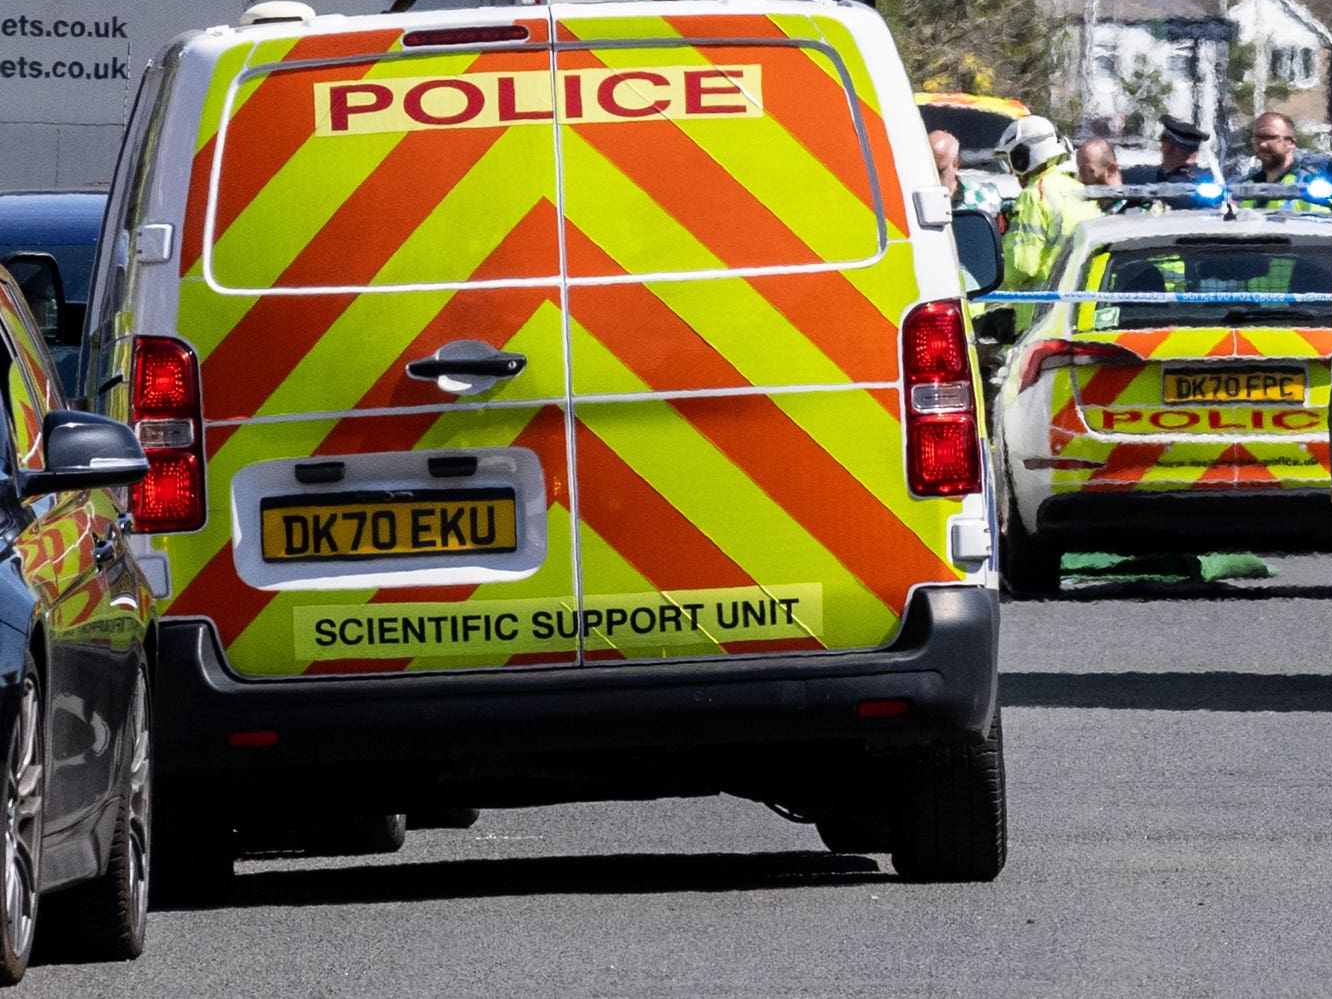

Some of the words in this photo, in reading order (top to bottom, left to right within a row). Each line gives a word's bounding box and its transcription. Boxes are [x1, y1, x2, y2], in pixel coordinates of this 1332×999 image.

[1, 15, 128, 38] ets.co.uk
[0, 57, 129, 80] ets.co.uk
[328, 70, 745, 132] POLICE
[1176, 376, 1240, 399] DK70
[1246, 374, 1294, 397] FPC
[1102, 409, 1320, 430] POLIC
[282, 510, 397, 555] DK70
[411, 505, 496, 548] EKU
[314, 609, 519, 646] SCIENTIFIC
[531, 602, 705, 642] SUPPORT
[717, 597, 800, 631] UNIT
